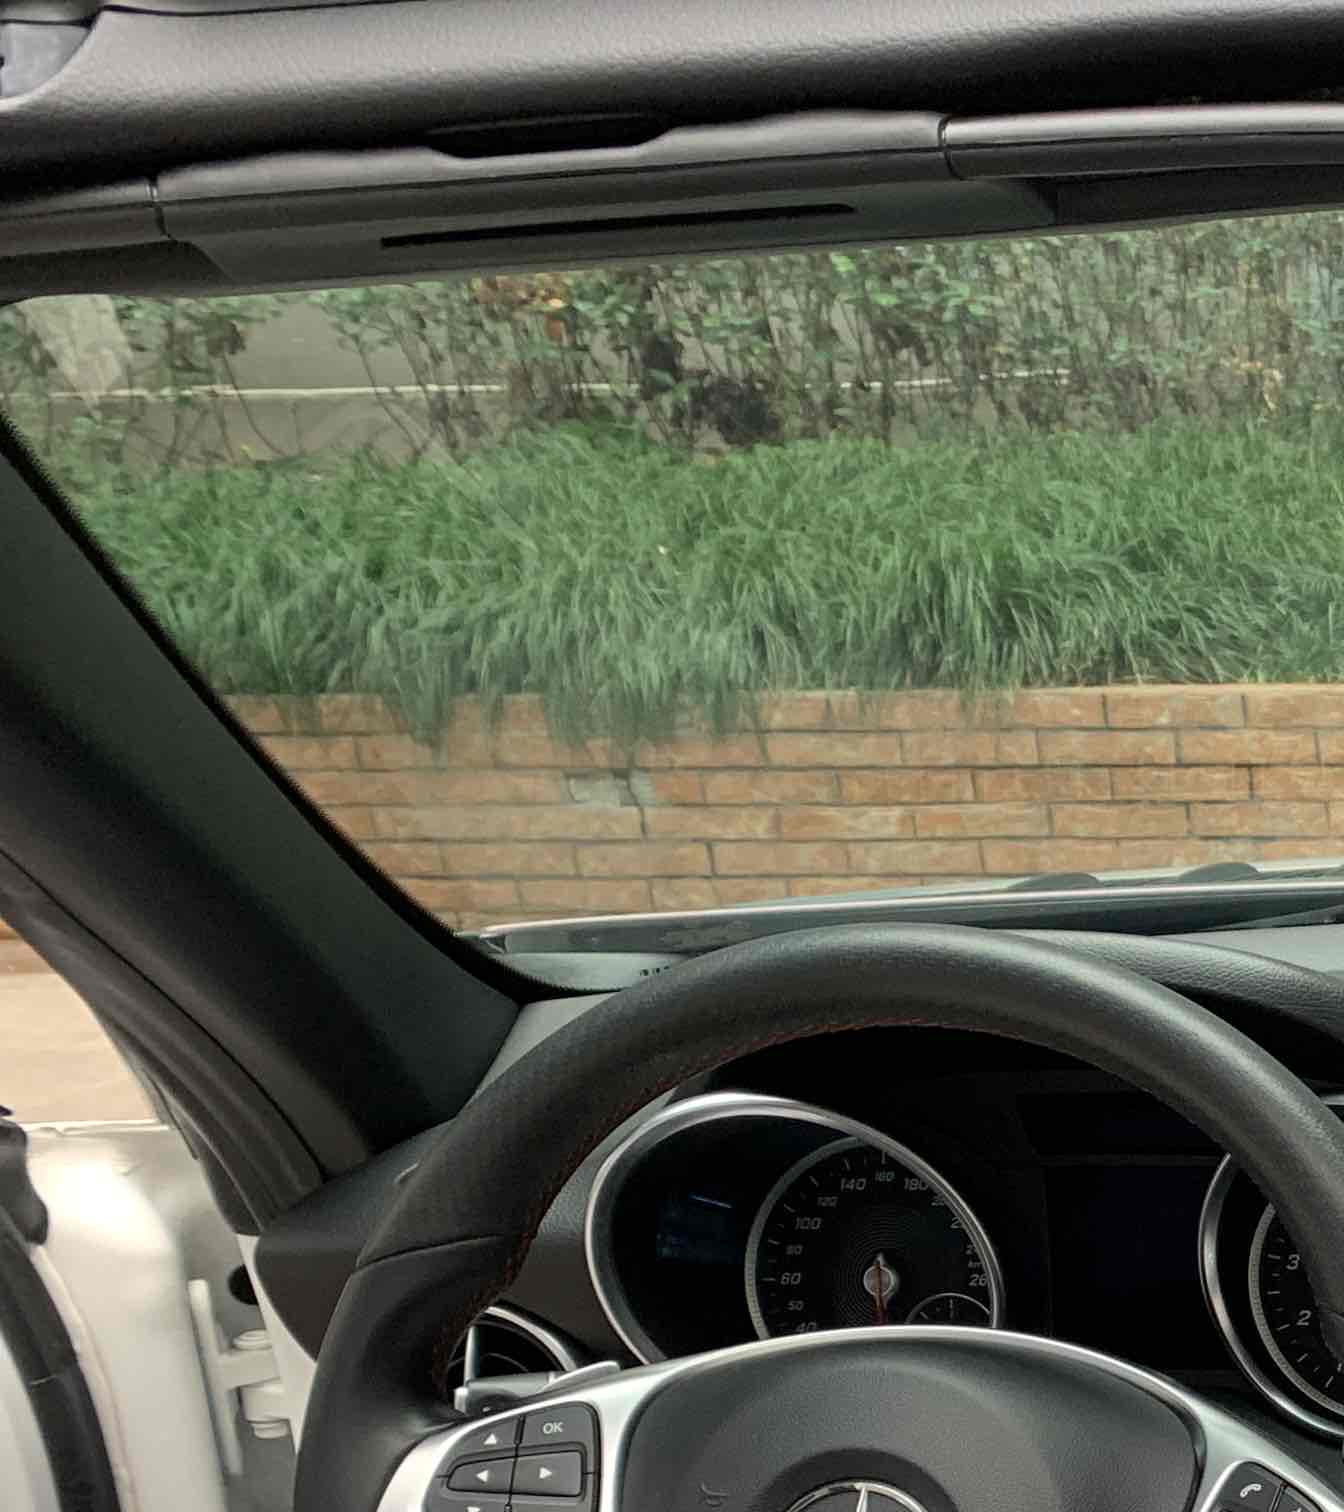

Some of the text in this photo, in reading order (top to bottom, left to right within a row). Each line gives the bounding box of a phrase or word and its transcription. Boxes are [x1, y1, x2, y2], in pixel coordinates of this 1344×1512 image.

[840, 1178, 866, 1191] 140
[795, 1217, 822, 1230] 100
[1286, 1254, 1300, 1270] 3
[780, 1272, 801, 1286] 60
[1297, 1310, 1311, 1326] 2
[542, 1421, 564, 1434] OK
